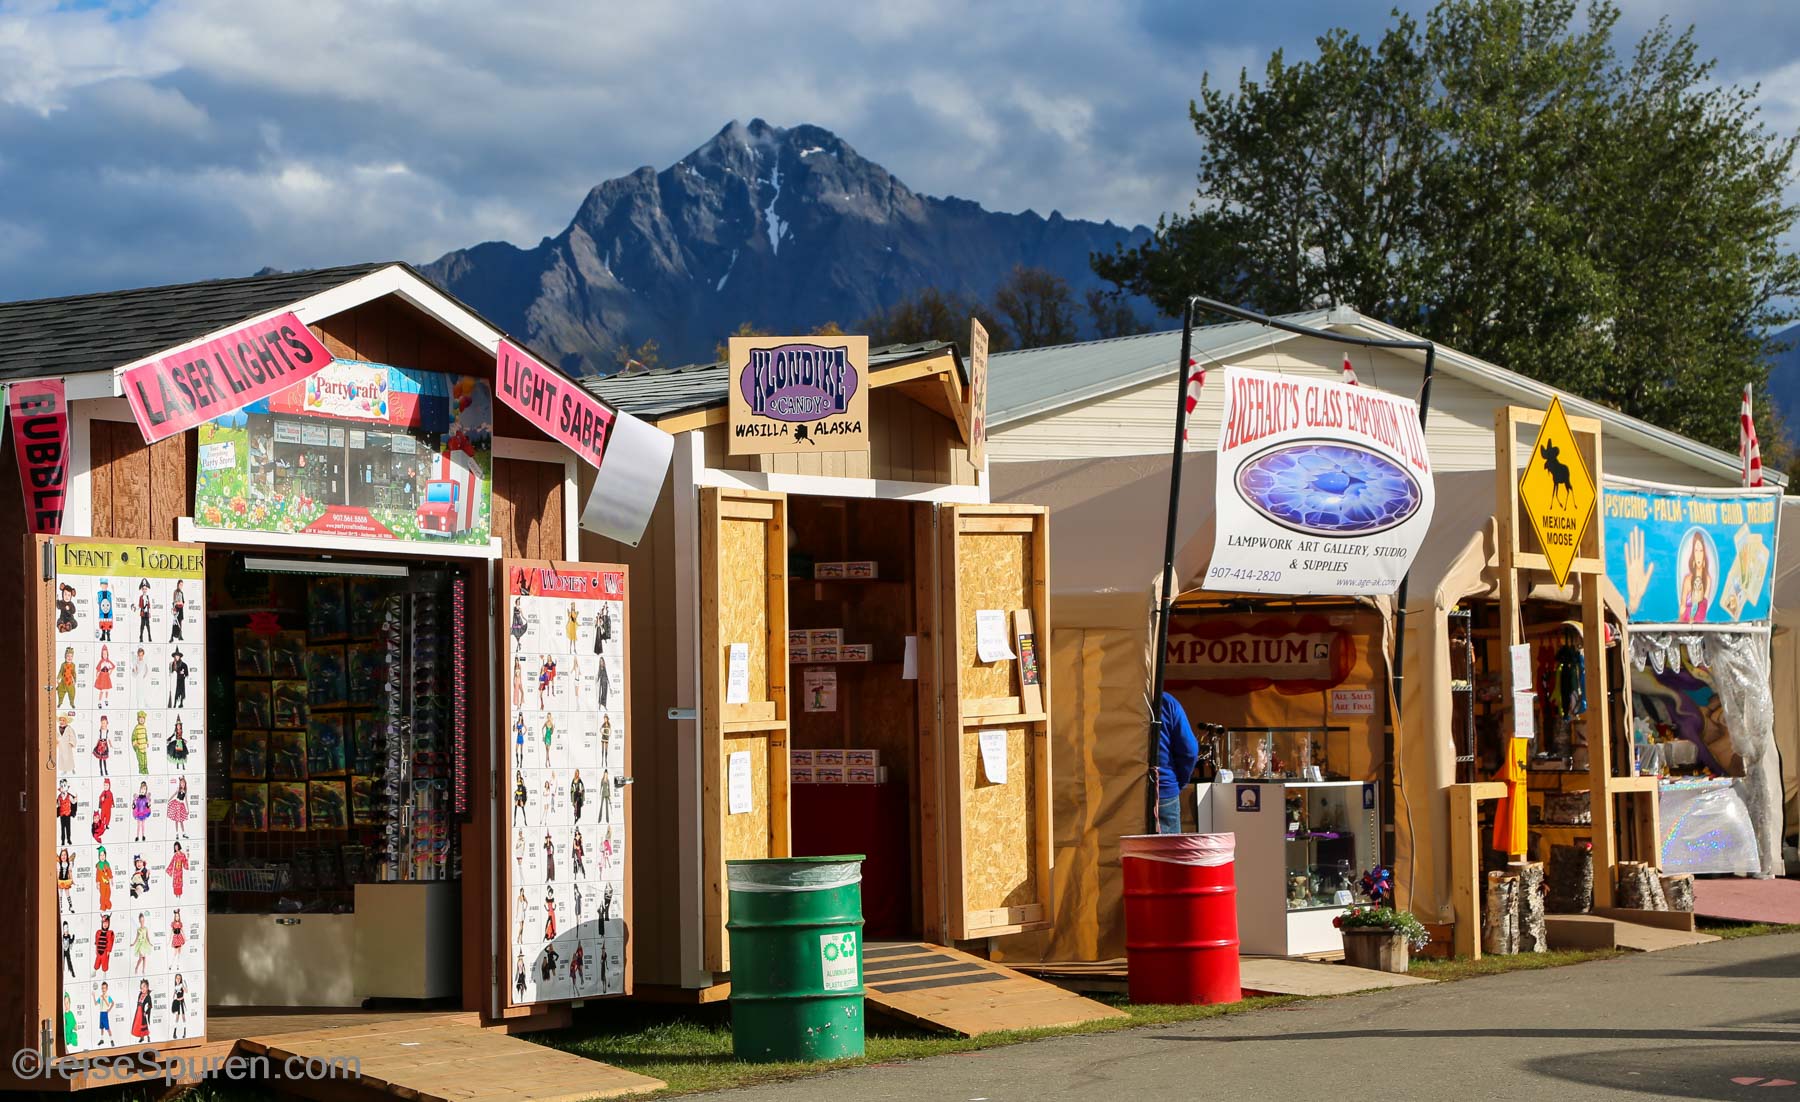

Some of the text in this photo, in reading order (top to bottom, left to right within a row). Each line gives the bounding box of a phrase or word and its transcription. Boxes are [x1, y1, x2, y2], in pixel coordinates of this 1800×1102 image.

[136, 325, 314, 427] LASER LIGHTS
[503, 354, 557, 422] LIGHT
[753, 349, 846, 412] KLONDIKE
[777, 396, 822, 415] CANDY
[735, 421, 862, 437] WASILLA ALASKA
[1223, 376, 1299, 452] AREHART'S
[1305, 386, 1343, 428] GLASS
[1399, 405, 1429, 474] LLC
[20, 393, 64, 530] BUBBLE
[1604, 493, 1648, 520] PSYCHIC
[1654, 498, 1682, 522] PALM
[1688, 501, 1717, 524] TAROT
[1720, 502, 1743, 525] CARD
[1542, 515, 1576, 530] MEXICAN
[1228, 535, 1408, 559] LAMPWORK ART GALLERY, STUDIO,
[1547, 532, 1573, 546] MOOSE
[62, 543, 203, 571] INFANT TODDLER
[1289, 559, 1349, 572] & SUPPLIES
[541, 568, 587, 592] WOMEN
[1210, 567, 1282, 582] 907-414-2820
[1336, 578, 1396, 588] www.age-ak.com
